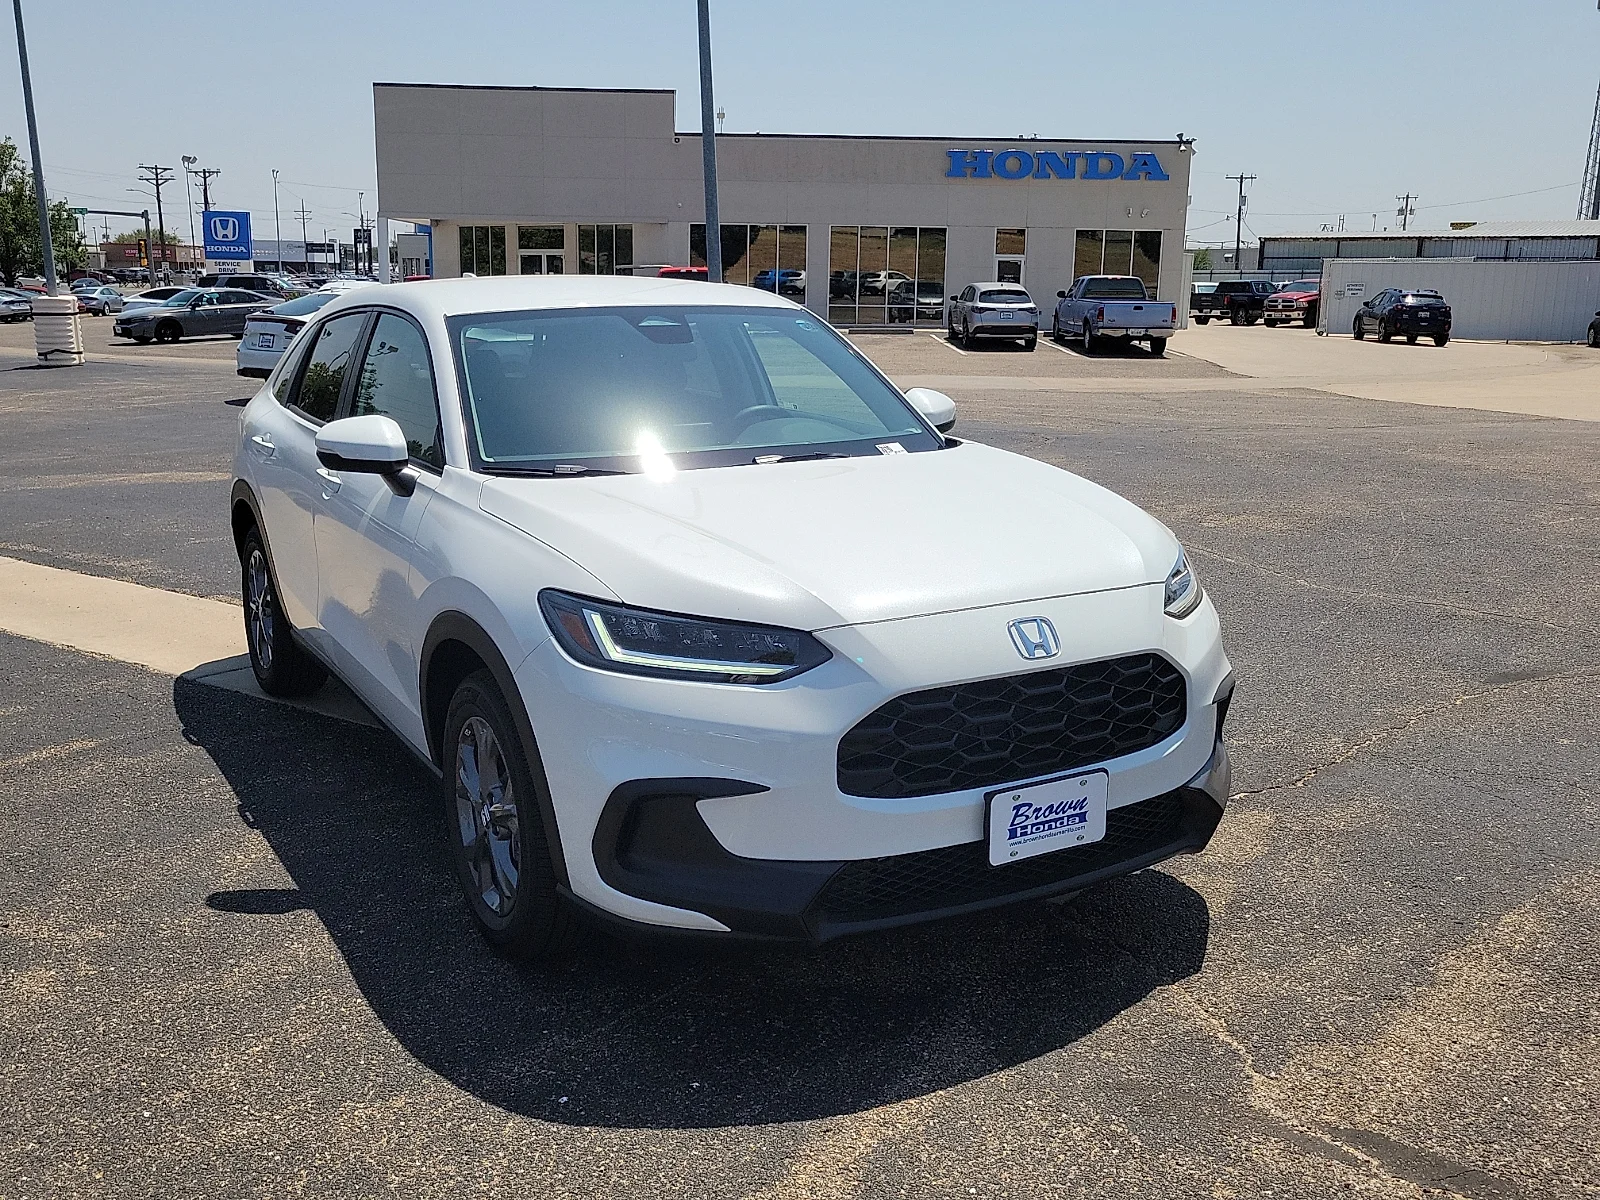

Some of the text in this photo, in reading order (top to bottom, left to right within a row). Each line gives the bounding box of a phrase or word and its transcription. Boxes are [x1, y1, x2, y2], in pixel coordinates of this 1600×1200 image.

[945, 149, 1170, 181] HONDA
[205, 245, 248, 253] HONDA
[1009, 796, 1088, 827] Brown
[1016, 815, 1080, 838] Honda
